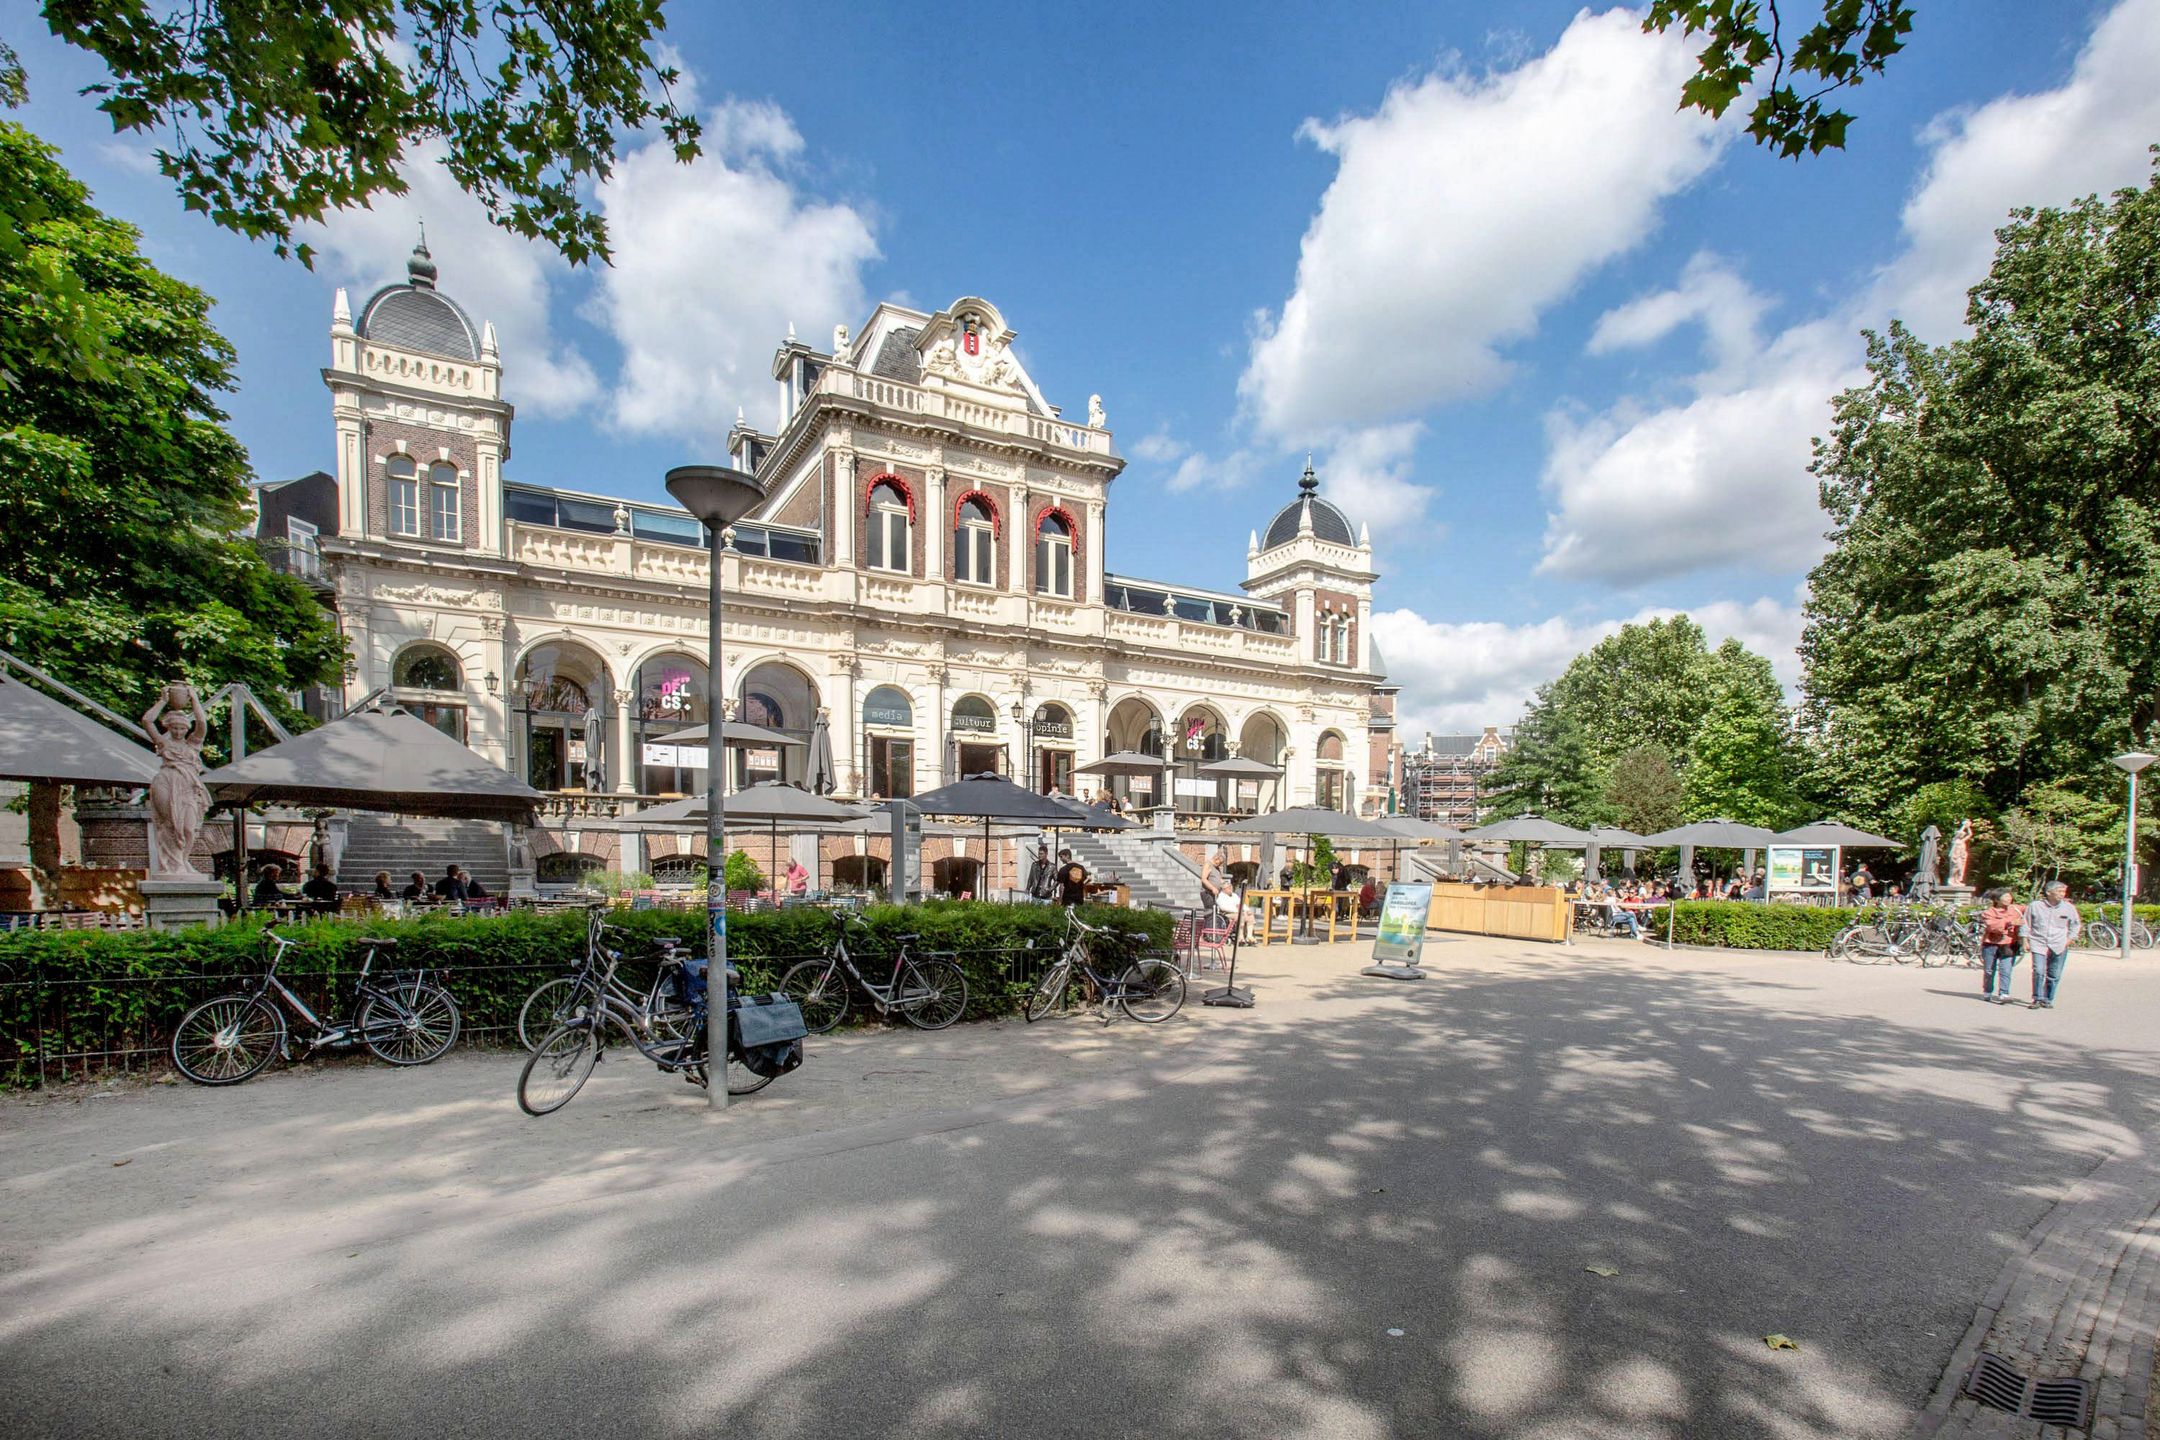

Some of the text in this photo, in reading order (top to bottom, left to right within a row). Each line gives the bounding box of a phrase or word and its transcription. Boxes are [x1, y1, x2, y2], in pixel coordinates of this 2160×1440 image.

[871, 709, 903, 721] media
[953, 717, 992, 728] cultuur
[1036, 722, 1068, 734] opinie
